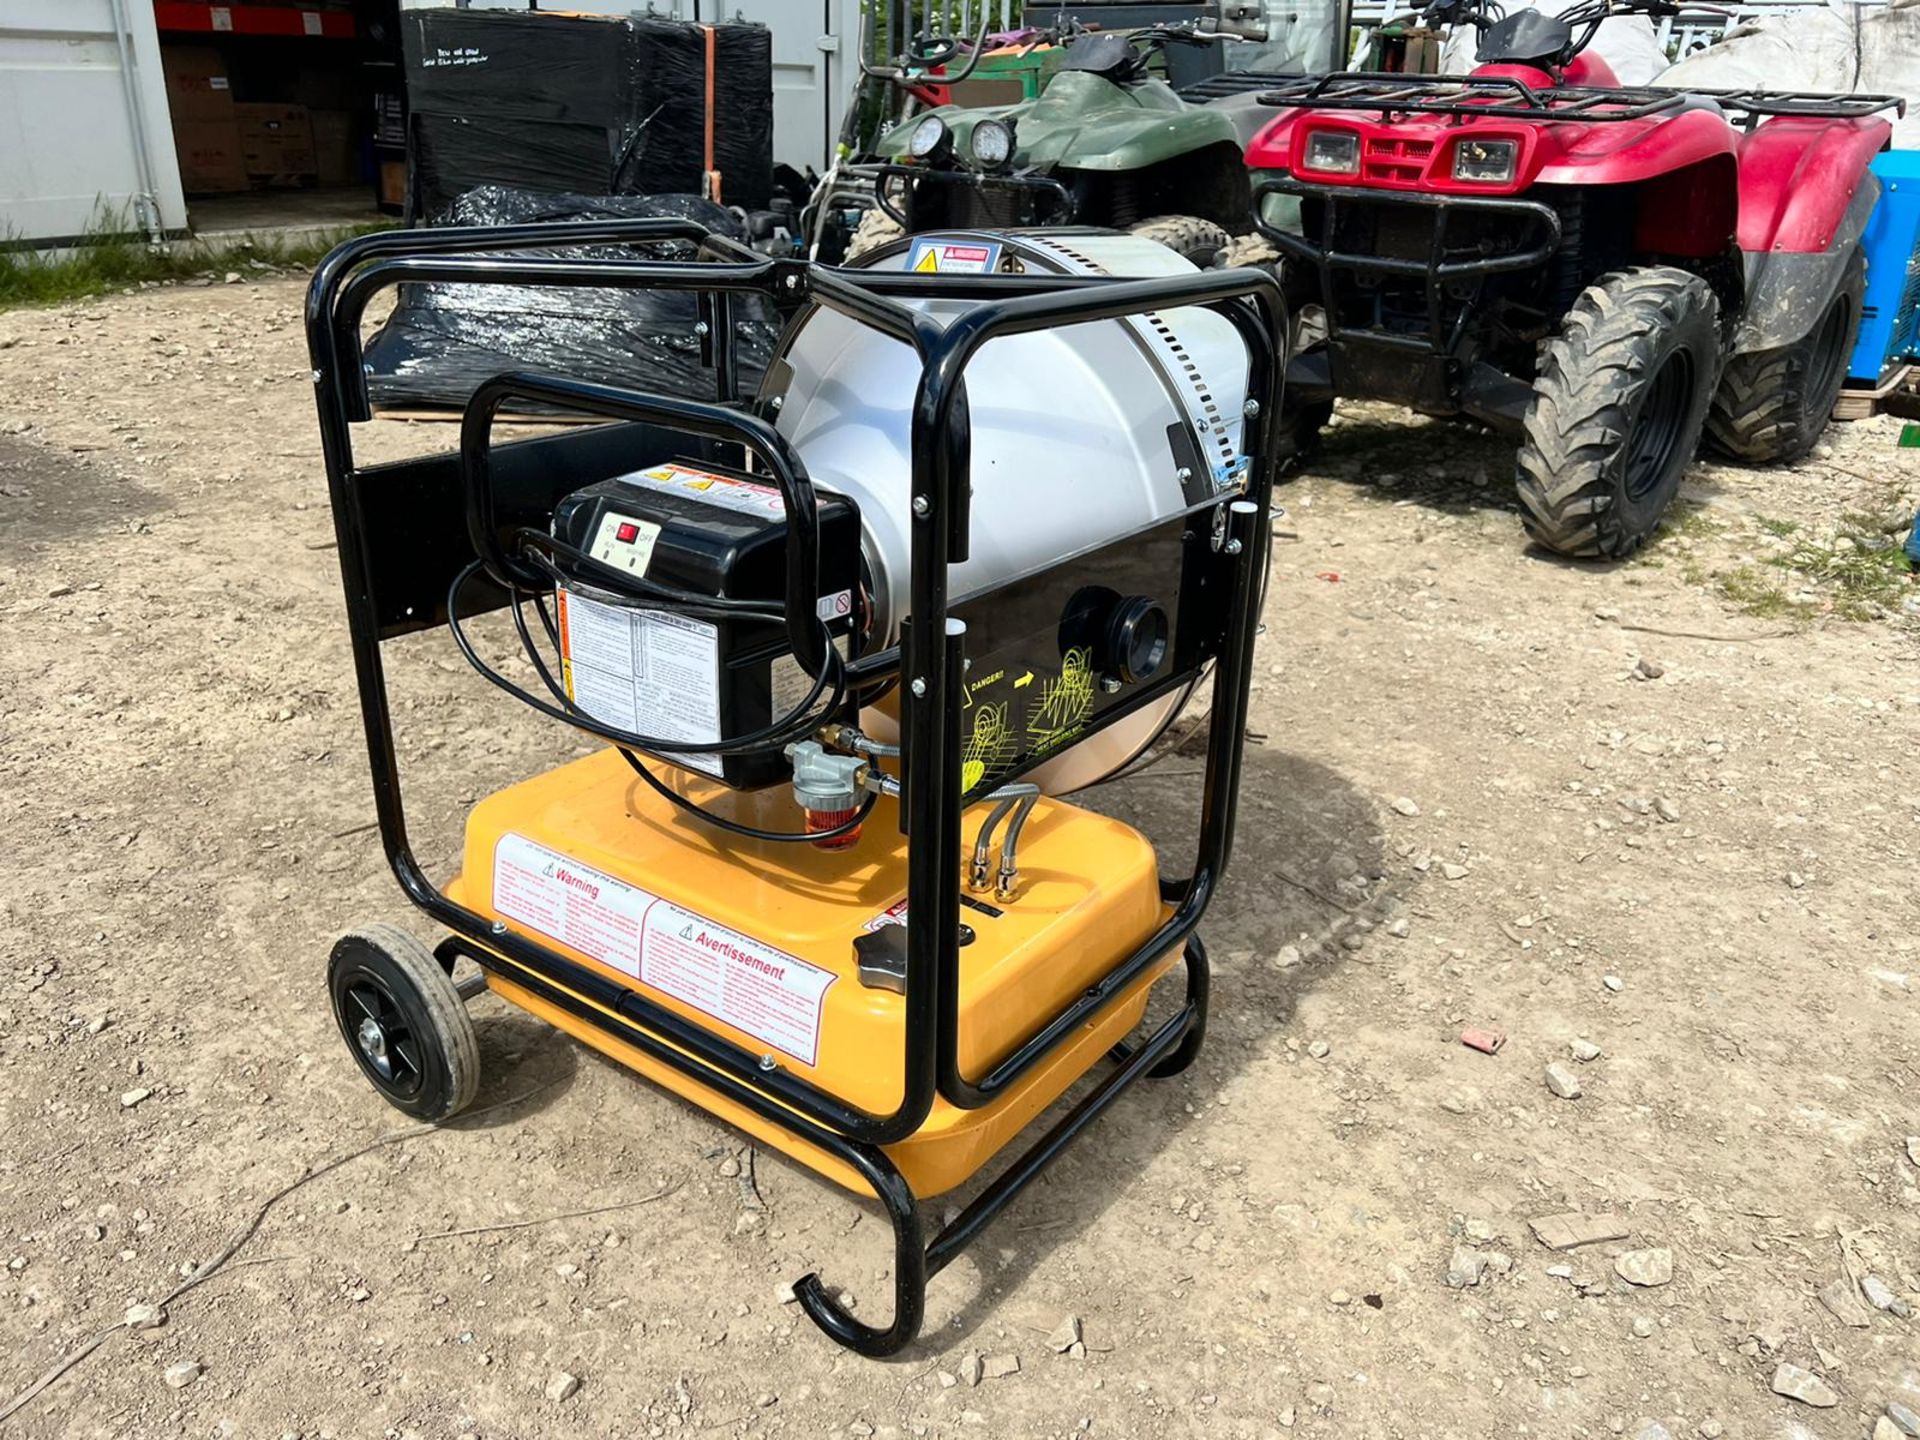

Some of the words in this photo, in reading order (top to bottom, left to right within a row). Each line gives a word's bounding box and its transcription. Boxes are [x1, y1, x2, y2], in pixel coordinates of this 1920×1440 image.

[605, 524, 616, 533] ON
[639, 533, 653, 542] OFF
[556, 867, 600, 900] Warning
[696, 931, 785, 981] Avertissement
